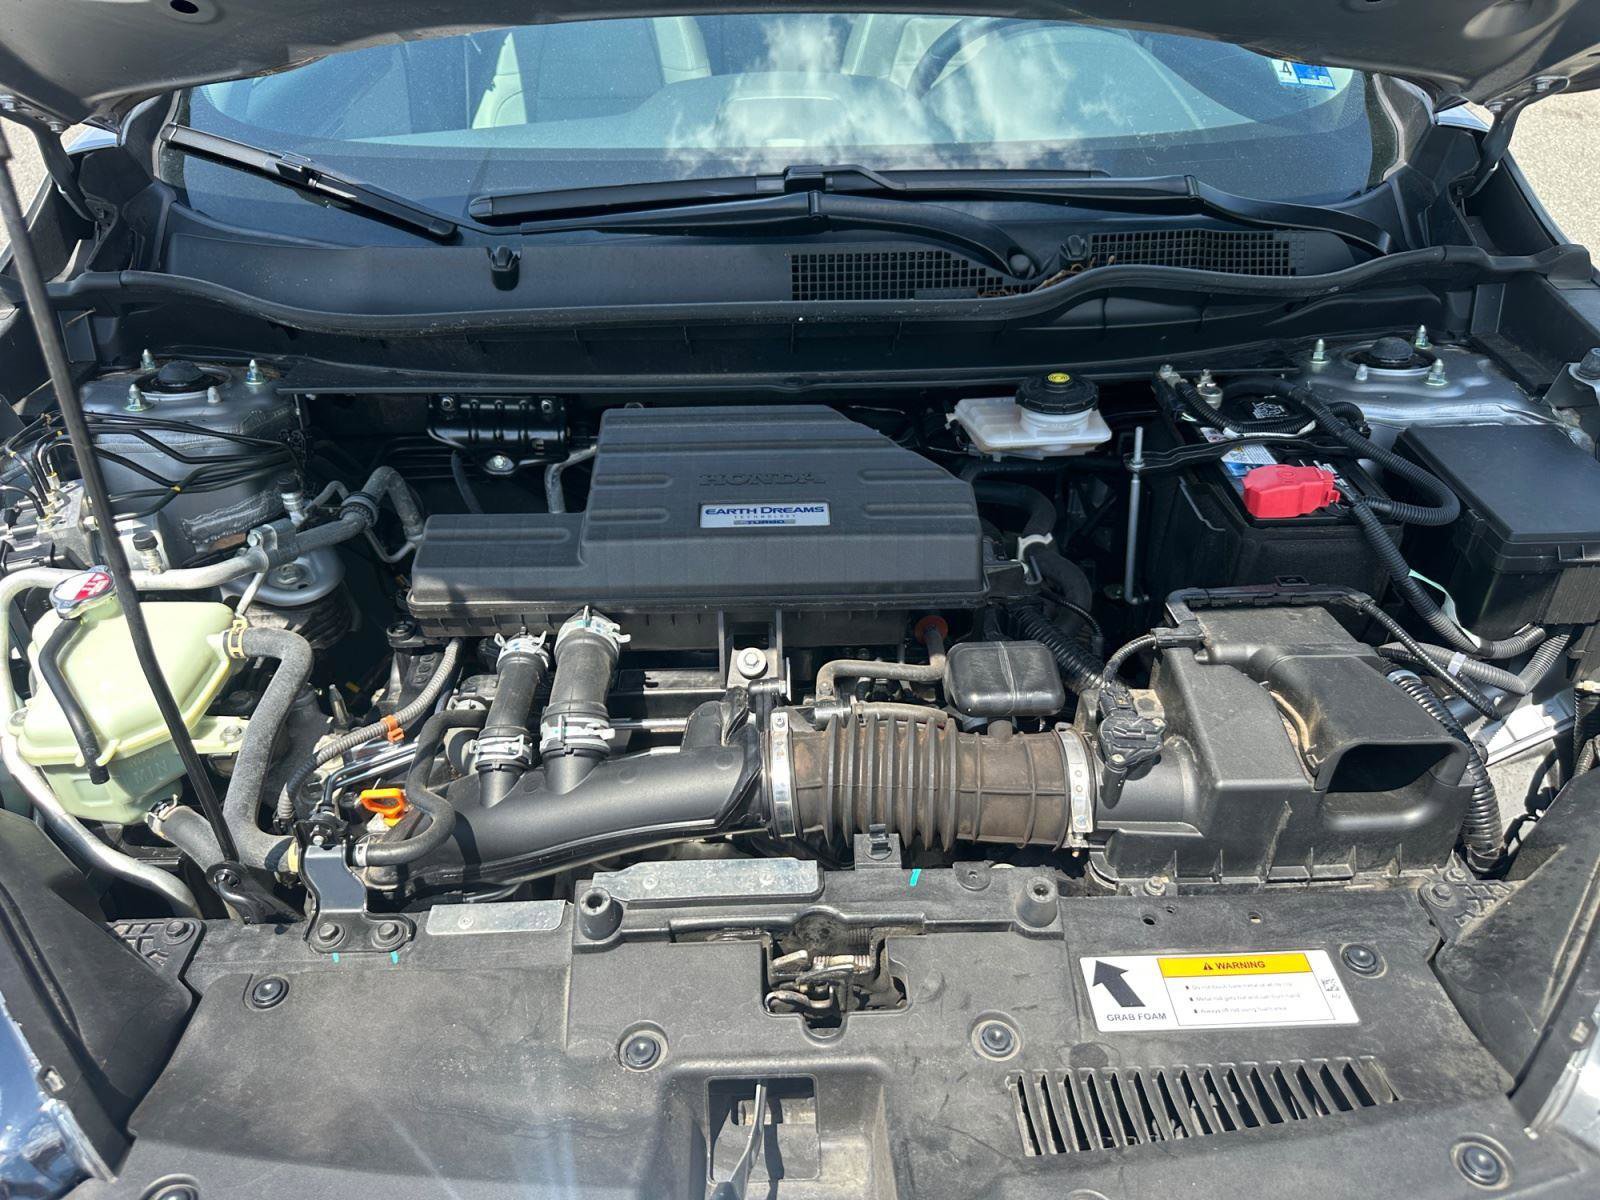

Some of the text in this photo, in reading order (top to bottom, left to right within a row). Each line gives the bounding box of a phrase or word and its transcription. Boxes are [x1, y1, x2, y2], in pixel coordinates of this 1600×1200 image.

[699, 472, 826, 487] HONDA
[1215, 960, 1266, 970] WARNING
[1106, 1012, 1167, 1022] GRAB FOAM
